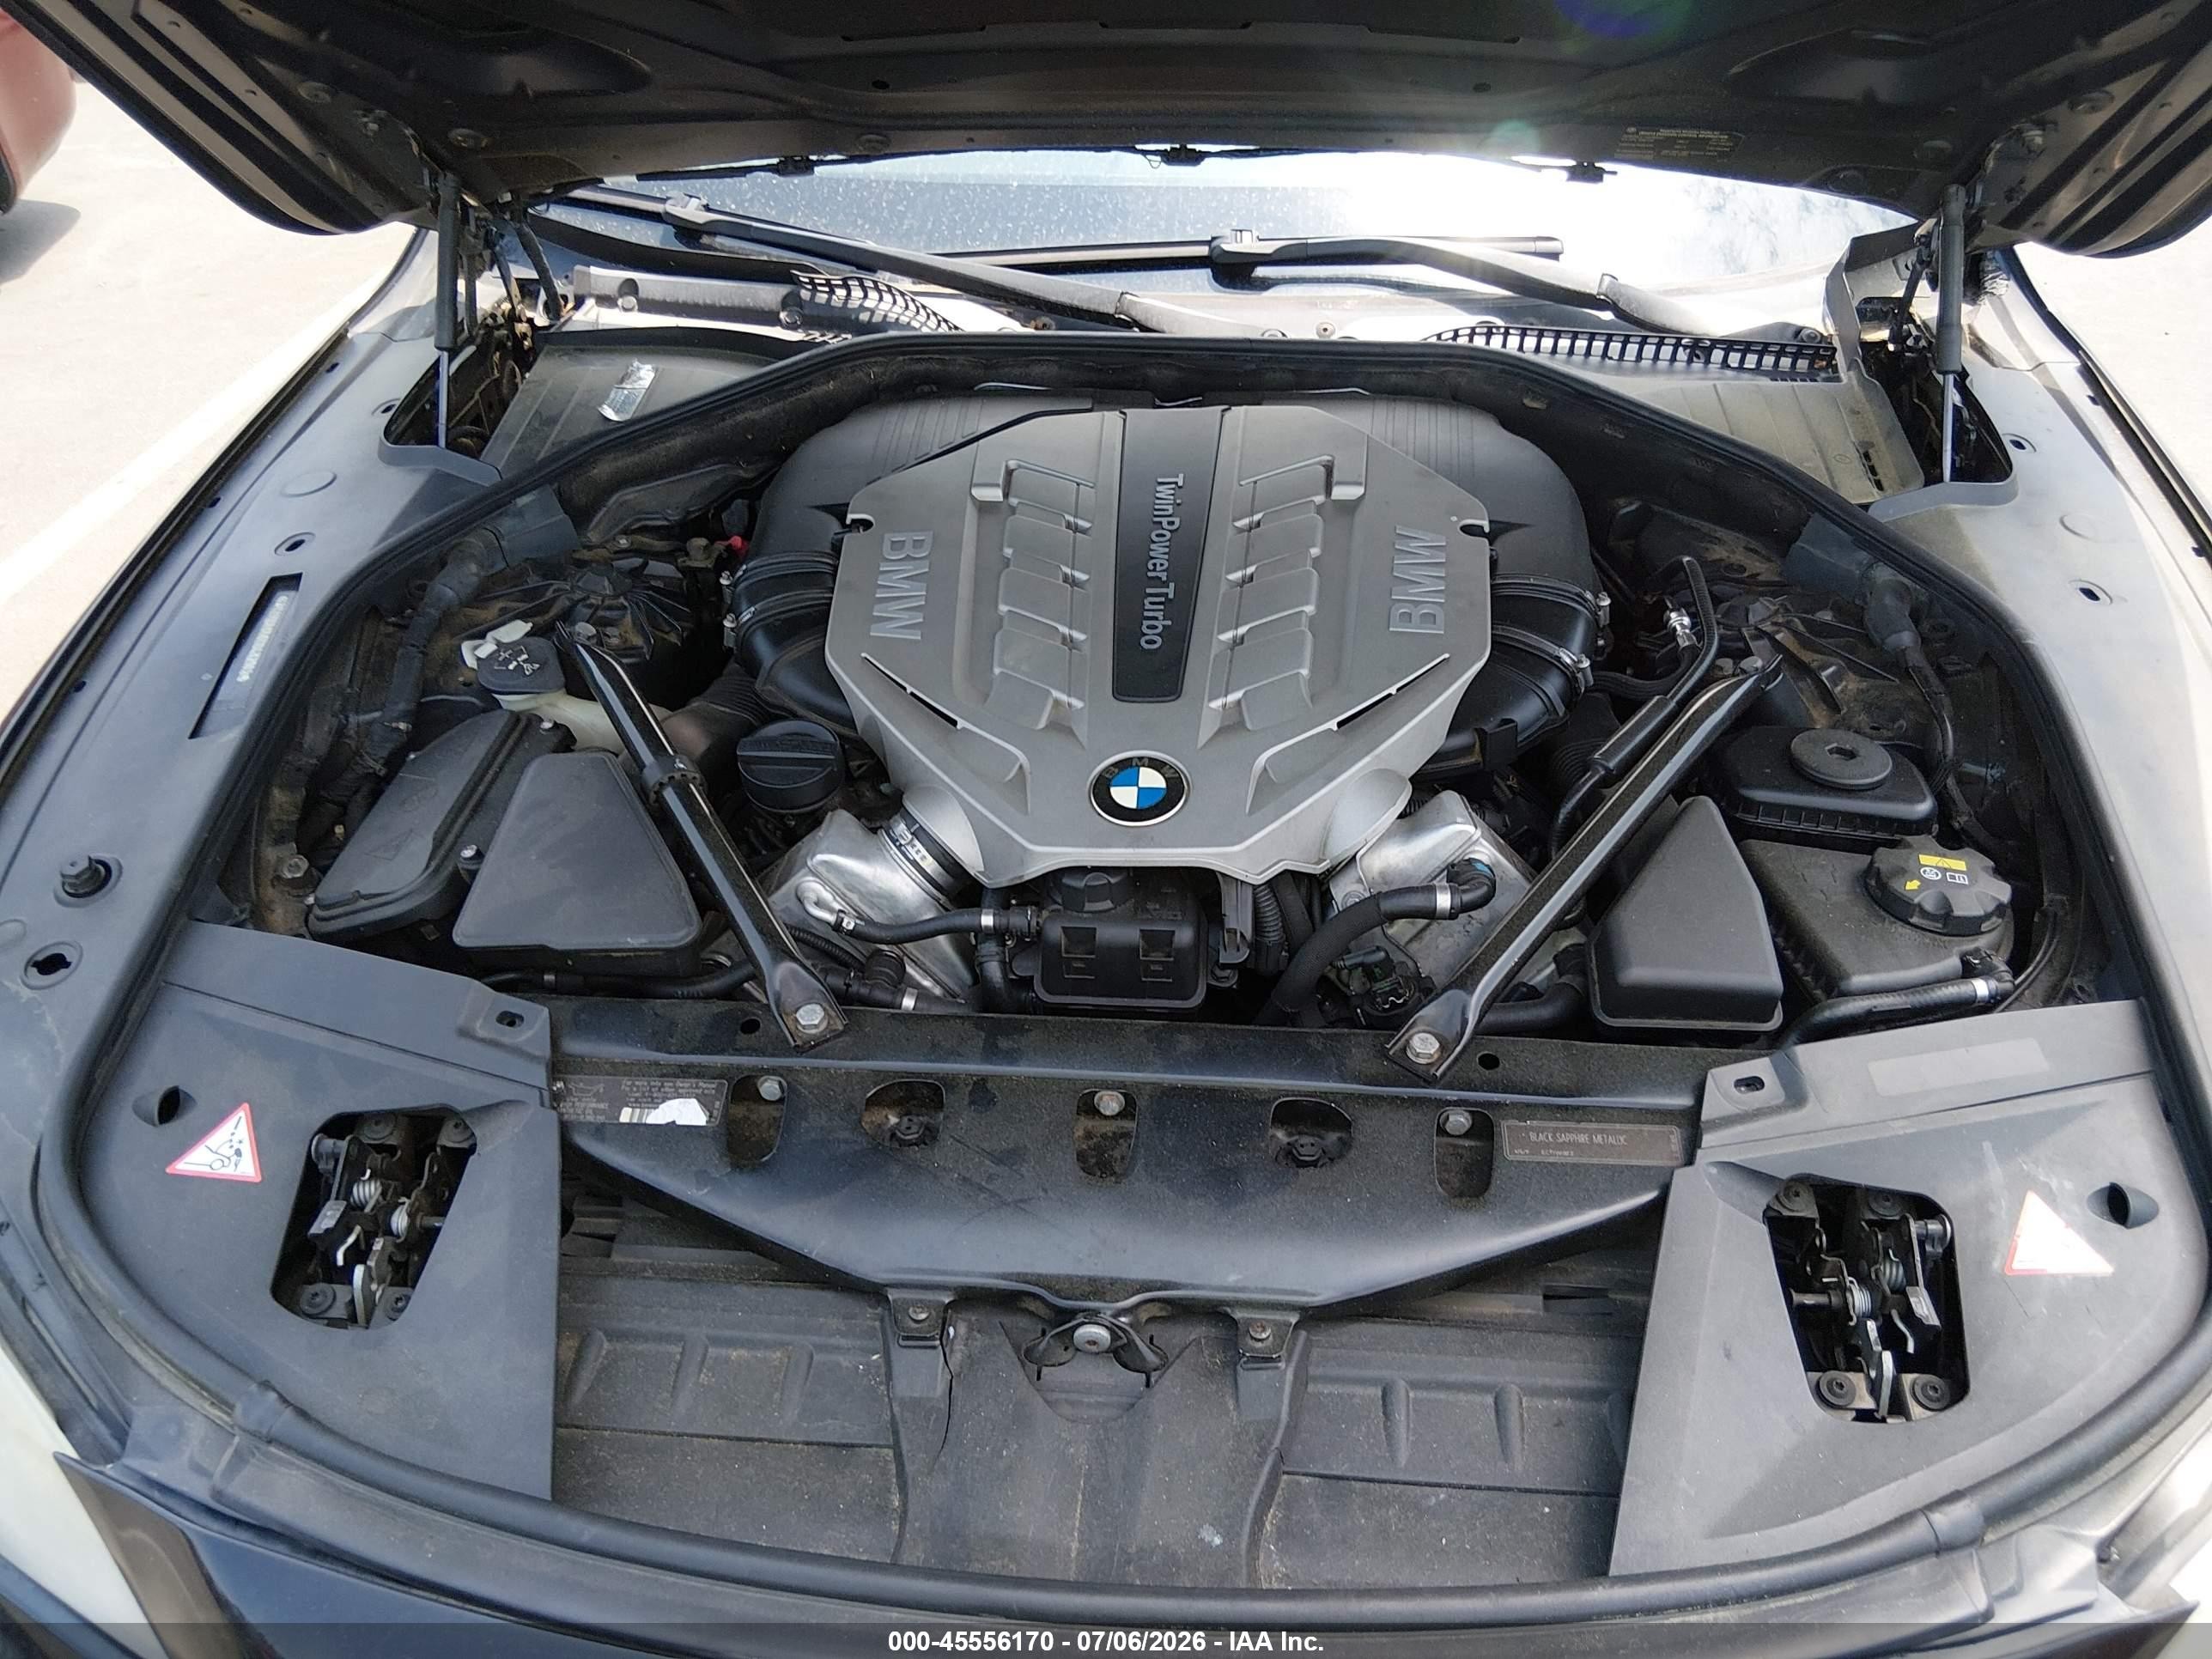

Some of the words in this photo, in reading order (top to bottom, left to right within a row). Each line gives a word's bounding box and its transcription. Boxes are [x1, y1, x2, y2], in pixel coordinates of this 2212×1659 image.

[1146, 472, 1184, 582] TwinPower
[1389, 525, 1446, 634] BMW
[870, 530, 934, 640] BMW
[1139, 581, 1176, 651] Turbo
[1528, 1132, 1553, 1143] BLACK
[1555, 1133, 1589, 1144] SAPPHIRE
[1591, 1133, 1627, 1146] METALLIC
